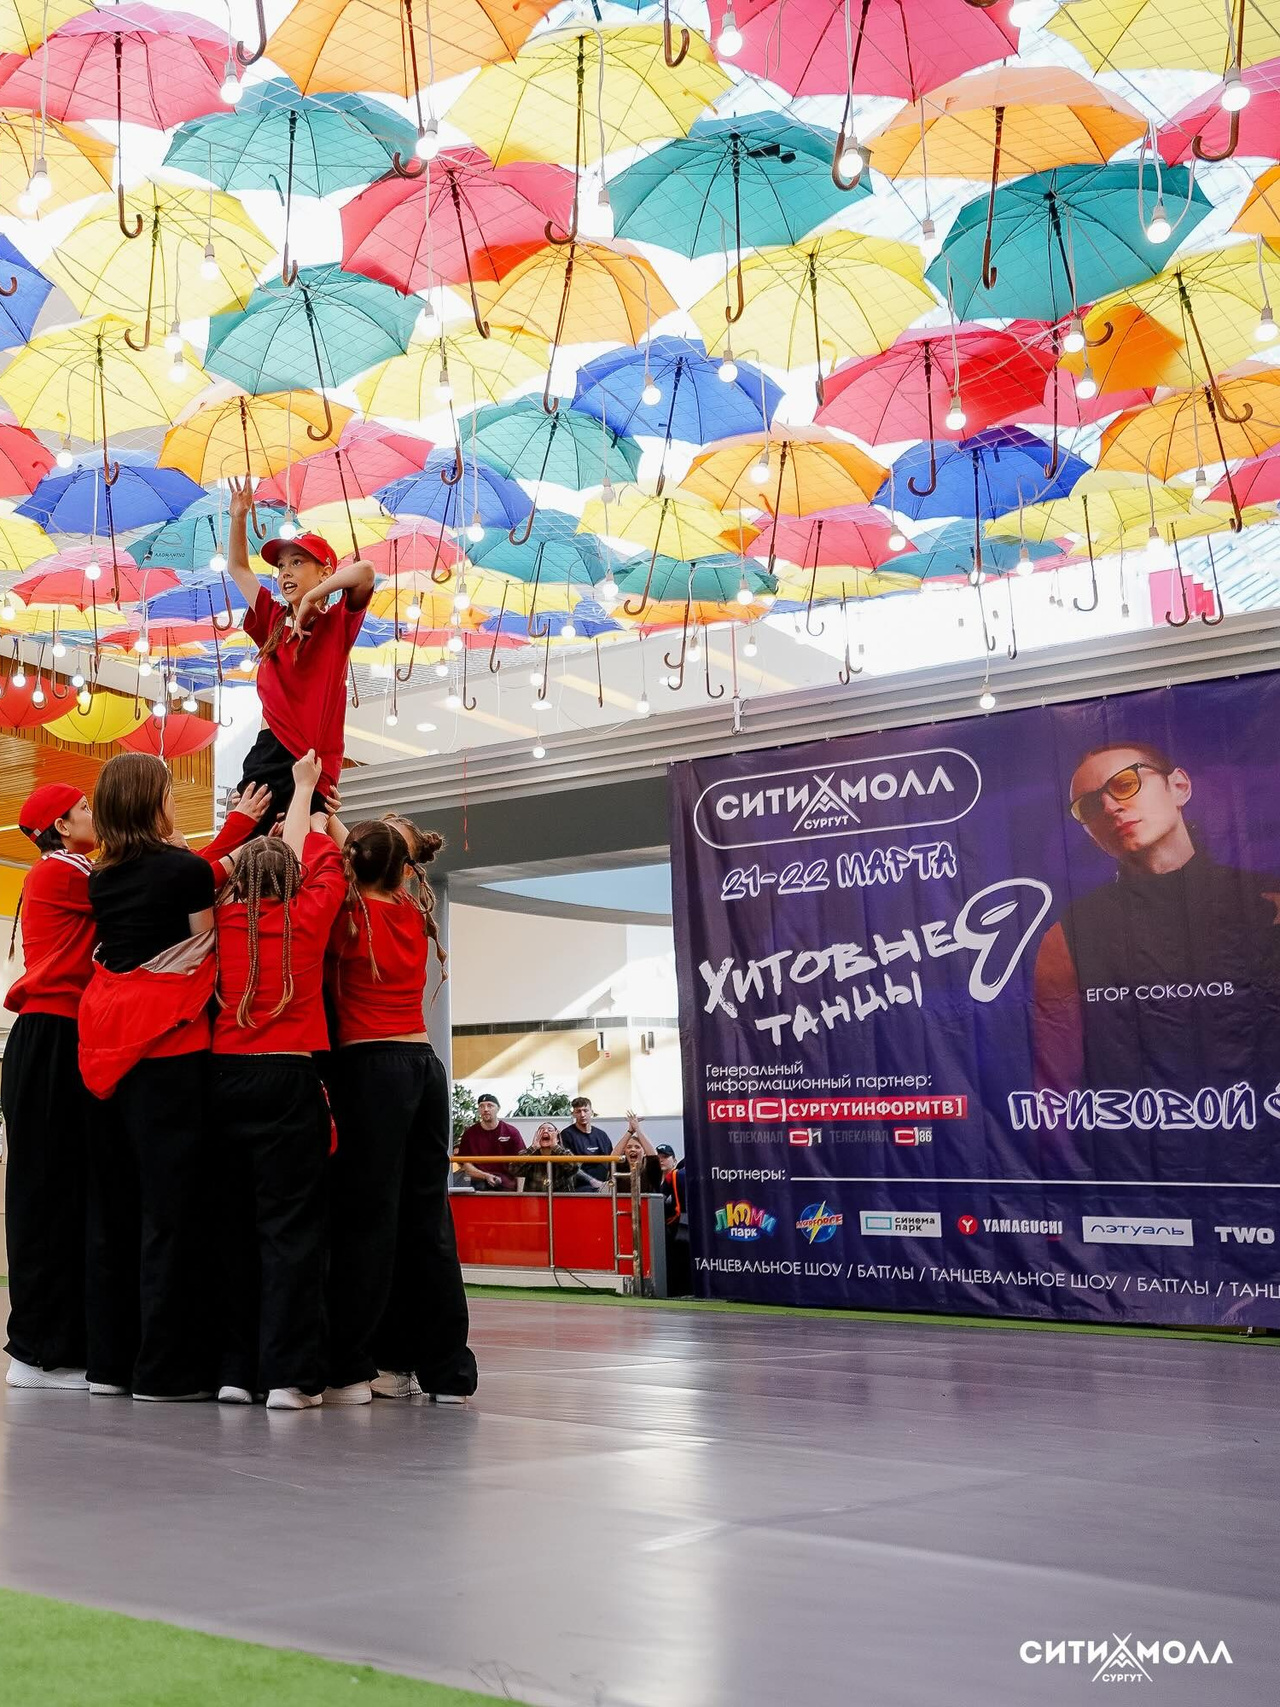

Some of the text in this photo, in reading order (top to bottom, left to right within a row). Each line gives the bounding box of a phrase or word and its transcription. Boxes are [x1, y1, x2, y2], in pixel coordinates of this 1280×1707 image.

[715, 765, 955, 821] СИТИ МОЛЛ
[804, 814, 849, 830] СУРГУТ
[720, 841, 958, 901] 21-22 МАРТА
[698, 920, 958, 1018] ХИТОВЫЕ
[1086, 981, 1234, 1002] ЕГОР СОКОЛОВ
[754, 971, 922, 1046] ТАНЦЫ
[706, 1060, 803, 1078] Генеральный
[706, 1074, 933, 1093] информационный партнер:
[1007, 1081, 1256, 1130] ПРИЗОВОЙ
[728, 1130, 783, 1144] ТЕЛЕКАНАЛ
[829, 1130, 889, 1144] ТЕЛЕКАНАЛ
[711, 1166, 786, 1183] Партнеры:
[730, 1227, 758, 1239] парк
[895, 1223, 922, 1233] парк
[983, 1218, 1063, 1234] YAMAGUCHI
[1214, 1226, 1275, 1245] TWO
[695, 1257, 801, 1276] ТАНЦЕВАЛЬНОЕ
[805, 1263, 842, 1277] ШОУ
[857, 1264, 914, 1280] БАТТЛЫ
[930, 1267, 1065, 1287] ТАНЦЕВАЛЬНОЕ
[1071, 1274, 1117, 1290] ШОУ
[1137, 1277, 1209, 1295] БАТТЛЫ
